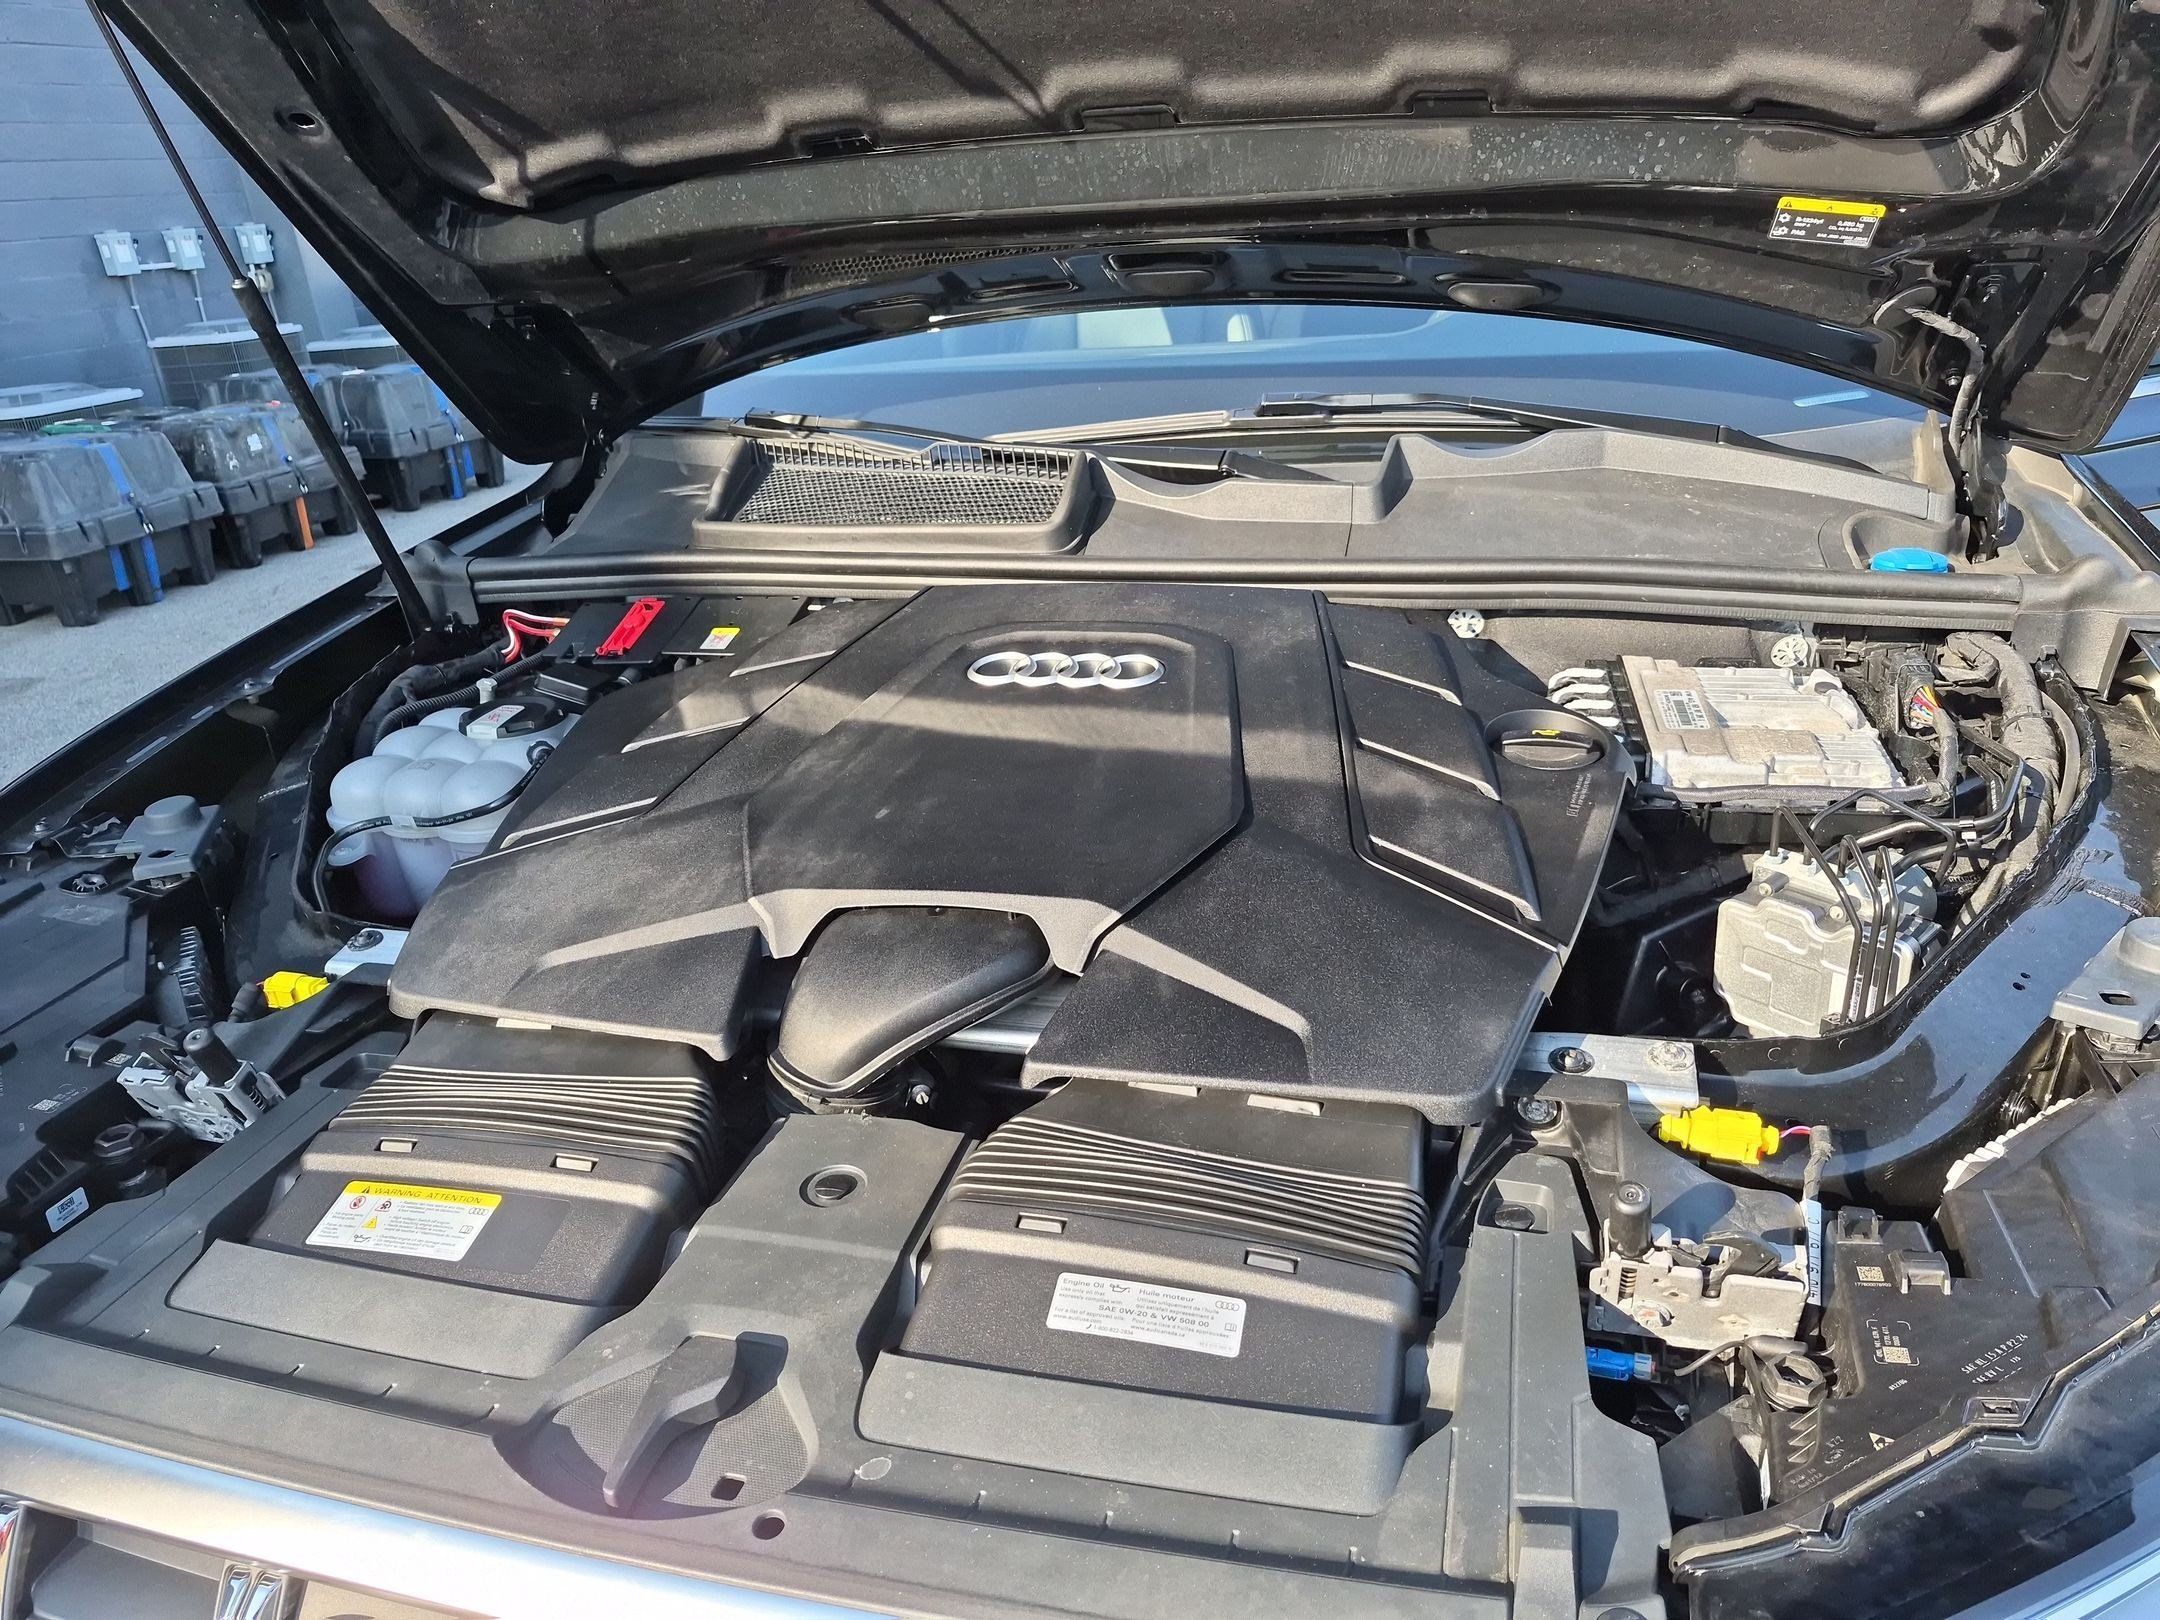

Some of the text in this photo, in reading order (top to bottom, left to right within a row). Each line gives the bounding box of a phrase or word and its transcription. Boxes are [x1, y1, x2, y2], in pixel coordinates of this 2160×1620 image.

[375, 1187, 482, 1204] WARNING ATTENTION
[1063, 1278, 1090, 1287] Engine
[1139, 1289, 1160, 1297] Huile
[1162, 1293, 1194, 1302] moteur
[1119, 1307, 1148, 1317] 0W-20
[1161, 1314, 1177, 1322] VW
[1179, 1317, 1195, 1325] 508
[1198, 1320, 1209, 1328] 00
[1961, 1363, 1978, 1374] SAE
[2015, 1333, 2028, 1342] 24
